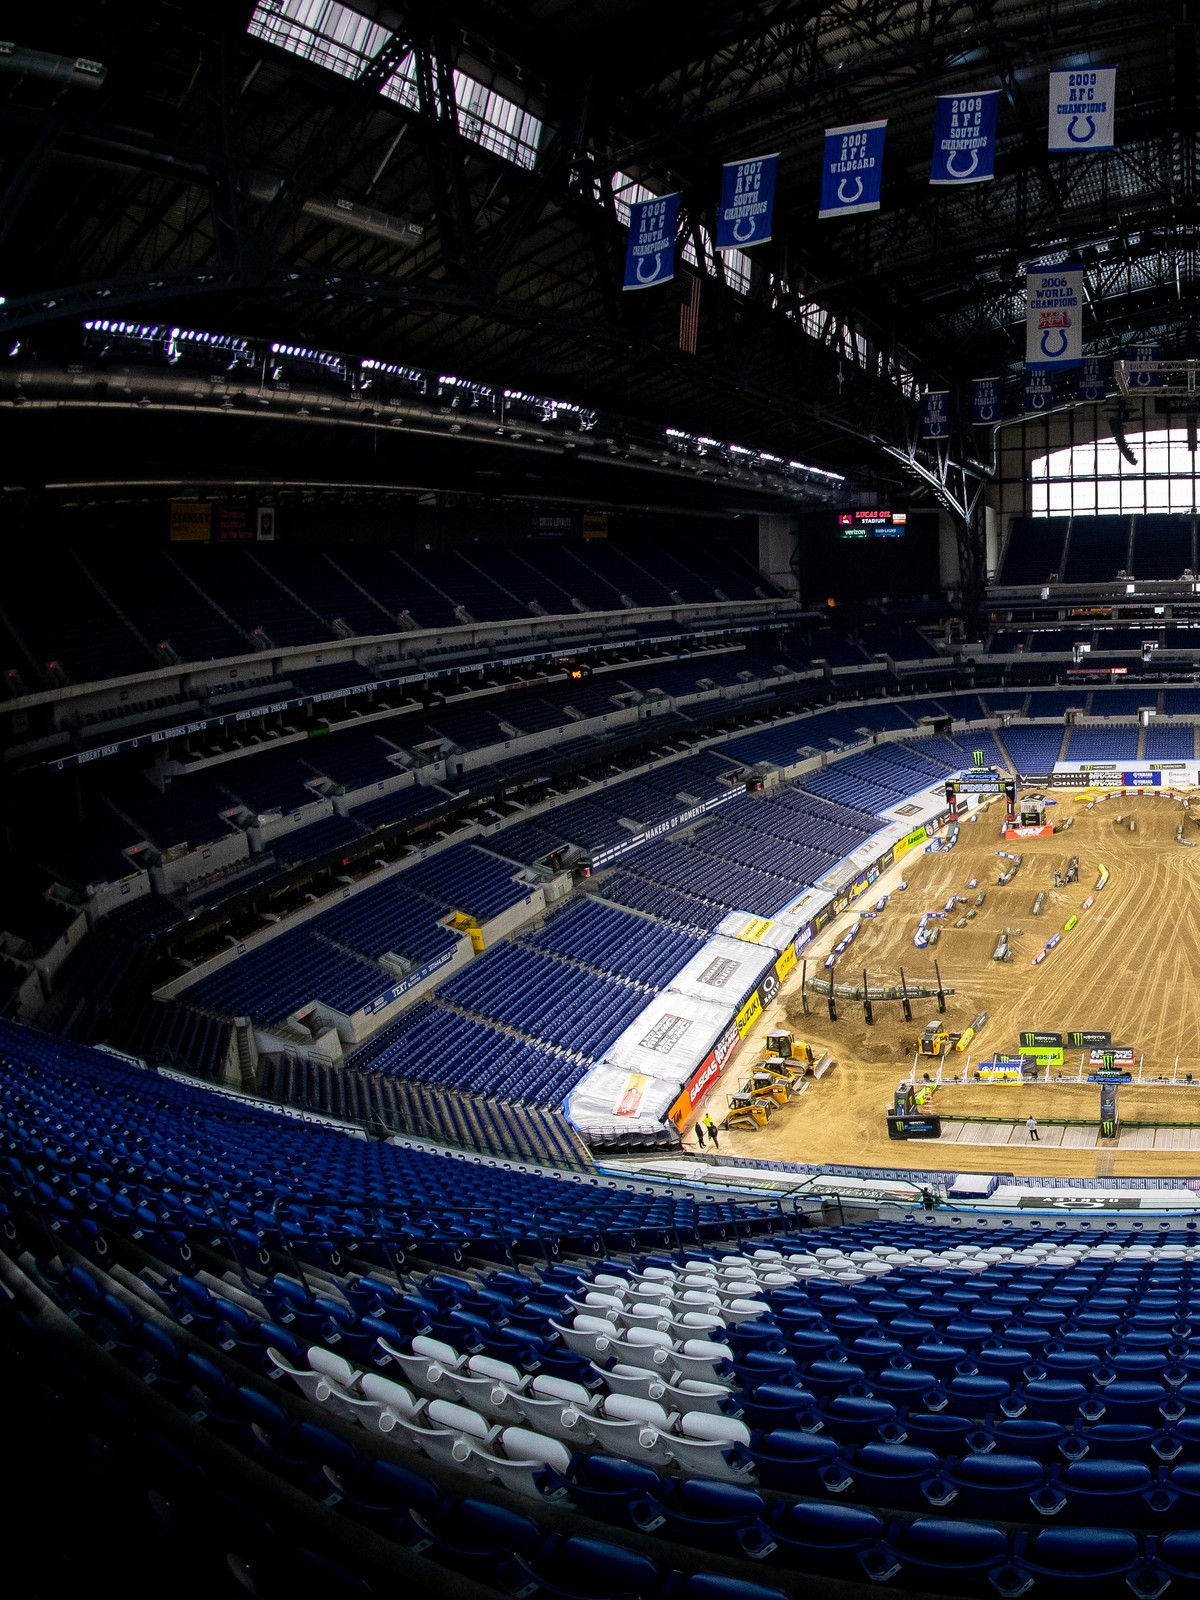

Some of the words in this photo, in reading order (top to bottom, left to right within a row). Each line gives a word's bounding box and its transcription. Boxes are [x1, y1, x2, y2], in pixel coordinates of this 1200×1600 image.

[1069, 73, 1097, 86] 2009
[951, 98, 982, 112] 2009
[1056, 102, 1107, 115] CHAMPIONS
[841, 133, 868, 147] 2008
[949, 126, 980, 139] SOUTH
[940, 136, 988, 151] CHAMPIONS
[737, 162, 763, 177] 2007
[830, 156, 875, 174] WILDCARD
[733, 190, 759, 206] SOUTH
[641, 201, 666, 218] 2006
[724, 201, 768, 220] CHAMPIONS
[639, 229, 663, 244] SOUTH
[632, 237, 669, 256] CHAMPIONS
[1041, 278, 1067, 288] 2006
[1036, 288, 1073, 299] WORLD
[1031, 297, 1078, 309] CHAMPIONS
[879, 510, 891, 518] OIL
[236, 711, 251, 721] CHRIS
[251, 707, 269, 718] HINTON
[151, 733, 164, 743] BILL
[165, 728, 186, 739] BROOKS
[78, 750, 101, 764] ROBERT
[101, 745, 119, 758] IRSAY
[959, 783, 999, 792] FINISH
[645, 820, 670, 841] MAKERS
[671, 816, 678, 828] OF
[679, 804, 706, 824] MOMENTS
[737, 998, 760, 1032] SUZUKI
[690, 1060, 718, 1102] GASGAS
